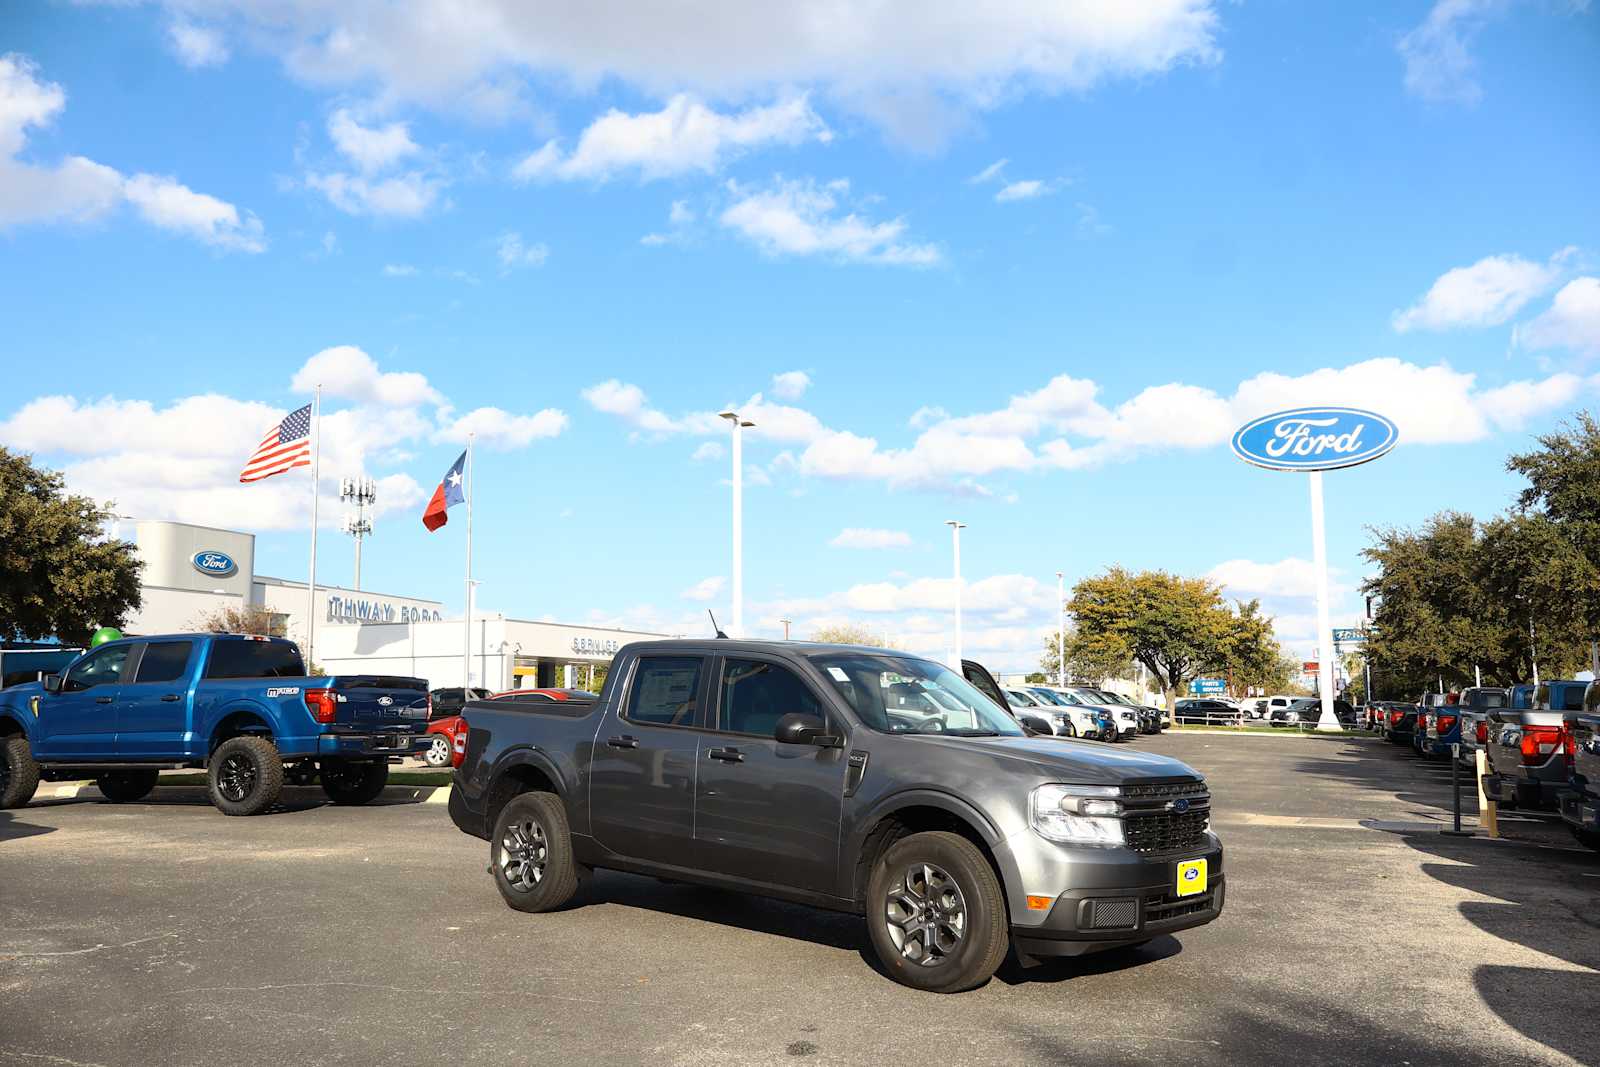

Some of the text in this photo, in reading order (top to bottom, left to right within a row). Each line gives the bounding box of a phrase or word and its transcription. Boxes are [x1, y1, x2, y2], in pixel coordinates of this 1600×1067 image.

[1266, 417, 1364, 457] Ford
[202, 554, 228, 569] Ford
[573, 637, 618, 651] SERVICE
